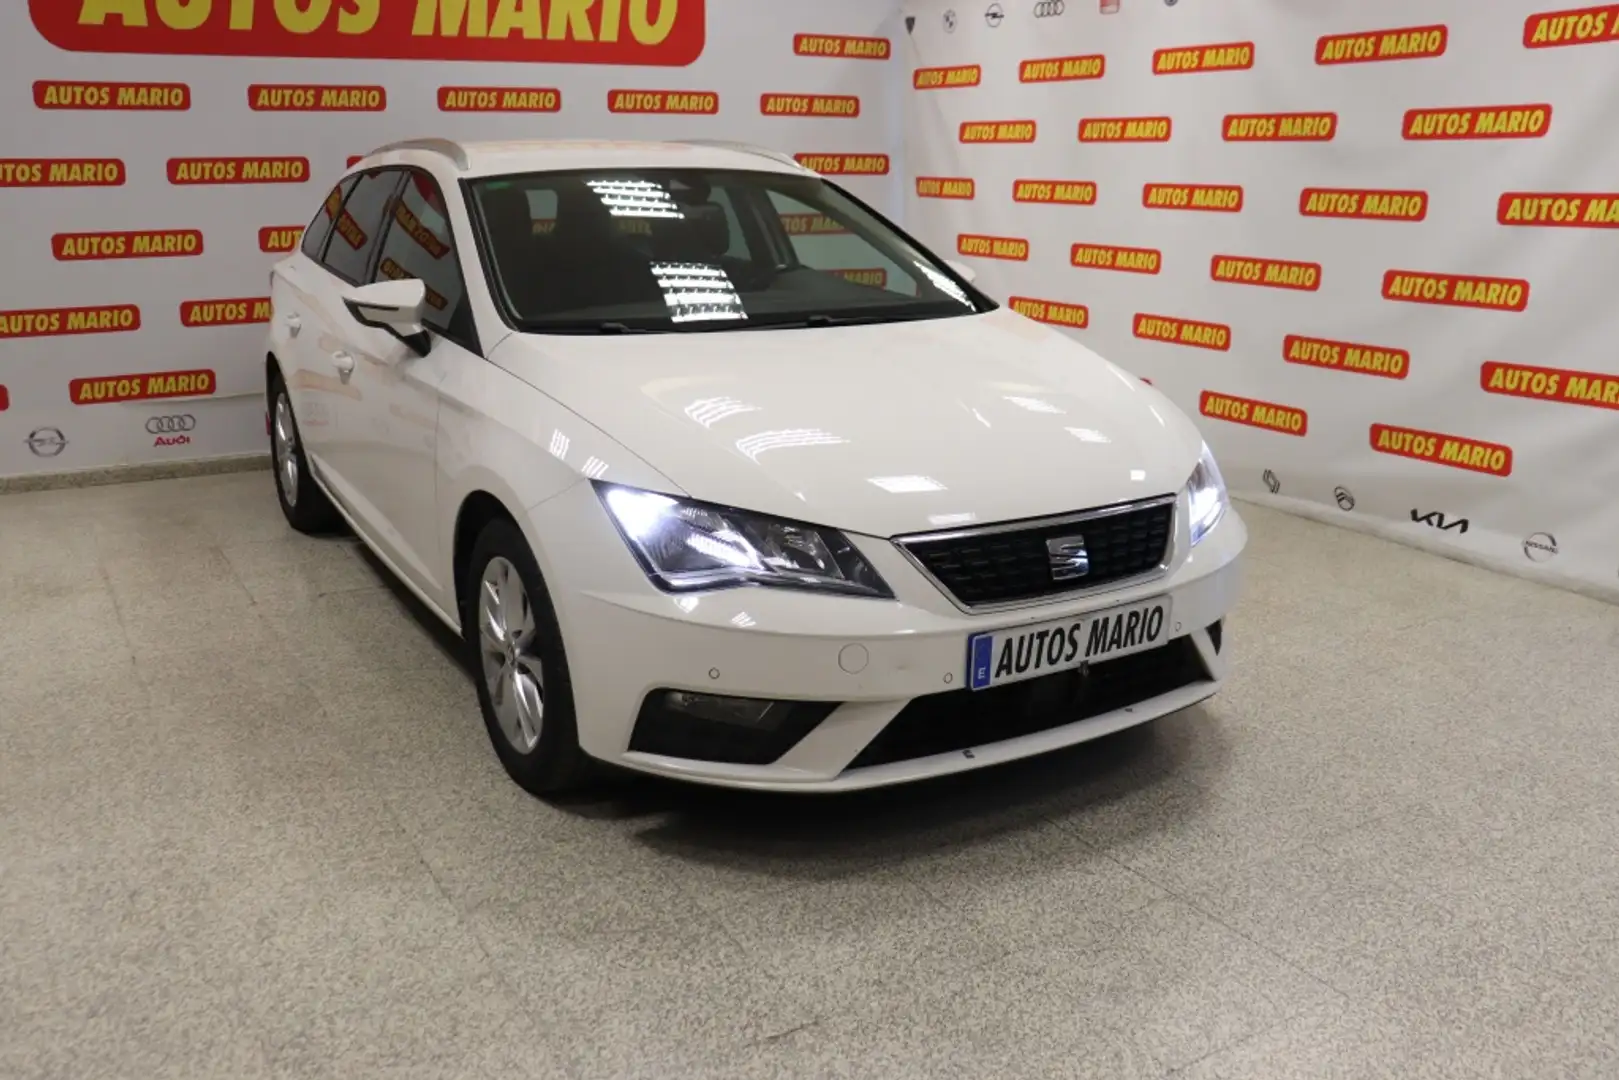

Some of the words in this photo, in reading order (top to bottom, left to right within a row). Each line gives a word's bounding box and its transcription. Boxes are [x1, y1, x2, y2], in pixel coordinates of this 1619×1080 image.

[1530, 11, 1609, 43] AUTOS
[800, 38, 842, 54] AUTOS
[844, 40, 889, 58] MARIO
[1323, 39, 1376, 60] AUTOS
[1380, 31, 1442, 56] MARIO
[1158, 53, 1200, 70] AUTOS
[1203, 48, 1251, 67] MARIO
[1023, 64, 1060, 80] AUTOS
[1062, 60, 1102, 76] MARIO
[44, 86, 111, 106] AUTOS
[116, 88, 185, 108] MARIO
[257, 89, 316, 108] AUTOS
[320, 90, 382, 108] MARIO
[445, 91, 498, 108] AUTOS
[502, 92, 556, 110] MARIO
[615, 94, 662, 111] AUTOS
[666, 95, 715, 111] MARIO
[767, 97, 810, 112] AUTOS
[812, 98, 856, 115] MARIO
[964, 127, 996, 140] AUTOS
[997, 125, 1034, 140] MARIO
[1085, 123, 1122, 139] AUTOS
[1125, 122, 1169, 138] MARIO
[1228, 119, 1277, 138] AUTOS
[1279, 119, 1332, 138] MARIO
[1410, 114, 1472, 136] AUTOS
[1475, 111, 1546, 134] MARIO
[48, 163, 119, 182] MARIO
[176, 162, 237, 181] AUTOS
[241, 162, 305, 180] MARIO
[843, 157, 886, 173] MARIO
[1018, 184, 1052, 200] AUTOS
[1054, 184, 1095, 202] MARIO
[1148, 189, 1189, 206] AUTOS
[1192, 190, 1241, 208] MARIO
[1306, 194, 1360, 214] AUTOS
[1363, 196, 1423, 217] MARIO
[1505, 198, 1581, 222] AUTOS
[62, 237, 127, 257] AUTOS
[132, 234, 198, 254] MARIO
[961, 239, 992, 253] AUTOS
[992, 241, 1027, 258] MARIO
[1076, 249, 1115, 266] AUTOS
[1115, 253, 1158, 270] MARIO
[1217, 262, 1262, 281] AUTOS
[1265, 264, 1317, 285] MARIO
[1389, 277, 1449, 300] AUTOS
[1454, 281, 1523, 306] MARIO
[66, 309, 134, 331] MARIO
[189, 303, 248, 323] AUTOS
[1047, 304, 1085, 325] MARIO
[1139, 320, 1178, 339] AUTOS
[1181, 326, 1228, 346] MARIO
[1290, 342, 1341, 364] AUTOS
[1343, 349, 1405, 373] MARIO
[79, 379, 142, 401] AUTOS
[147, 374, 210, 396] MARIO
[1488, 367, 1560, 396] AUTOS
[1206, 398, 1250, 420] AUTOS
[1252, 407, 1303, 430] MARIO
[1379, 431, 1437, 458] AUTOS
[1440, 442, 1507, 471] MARIO
[995, 623, 1081, 678] AUTOS
[1085, 605, 1164, 658] MARIO
